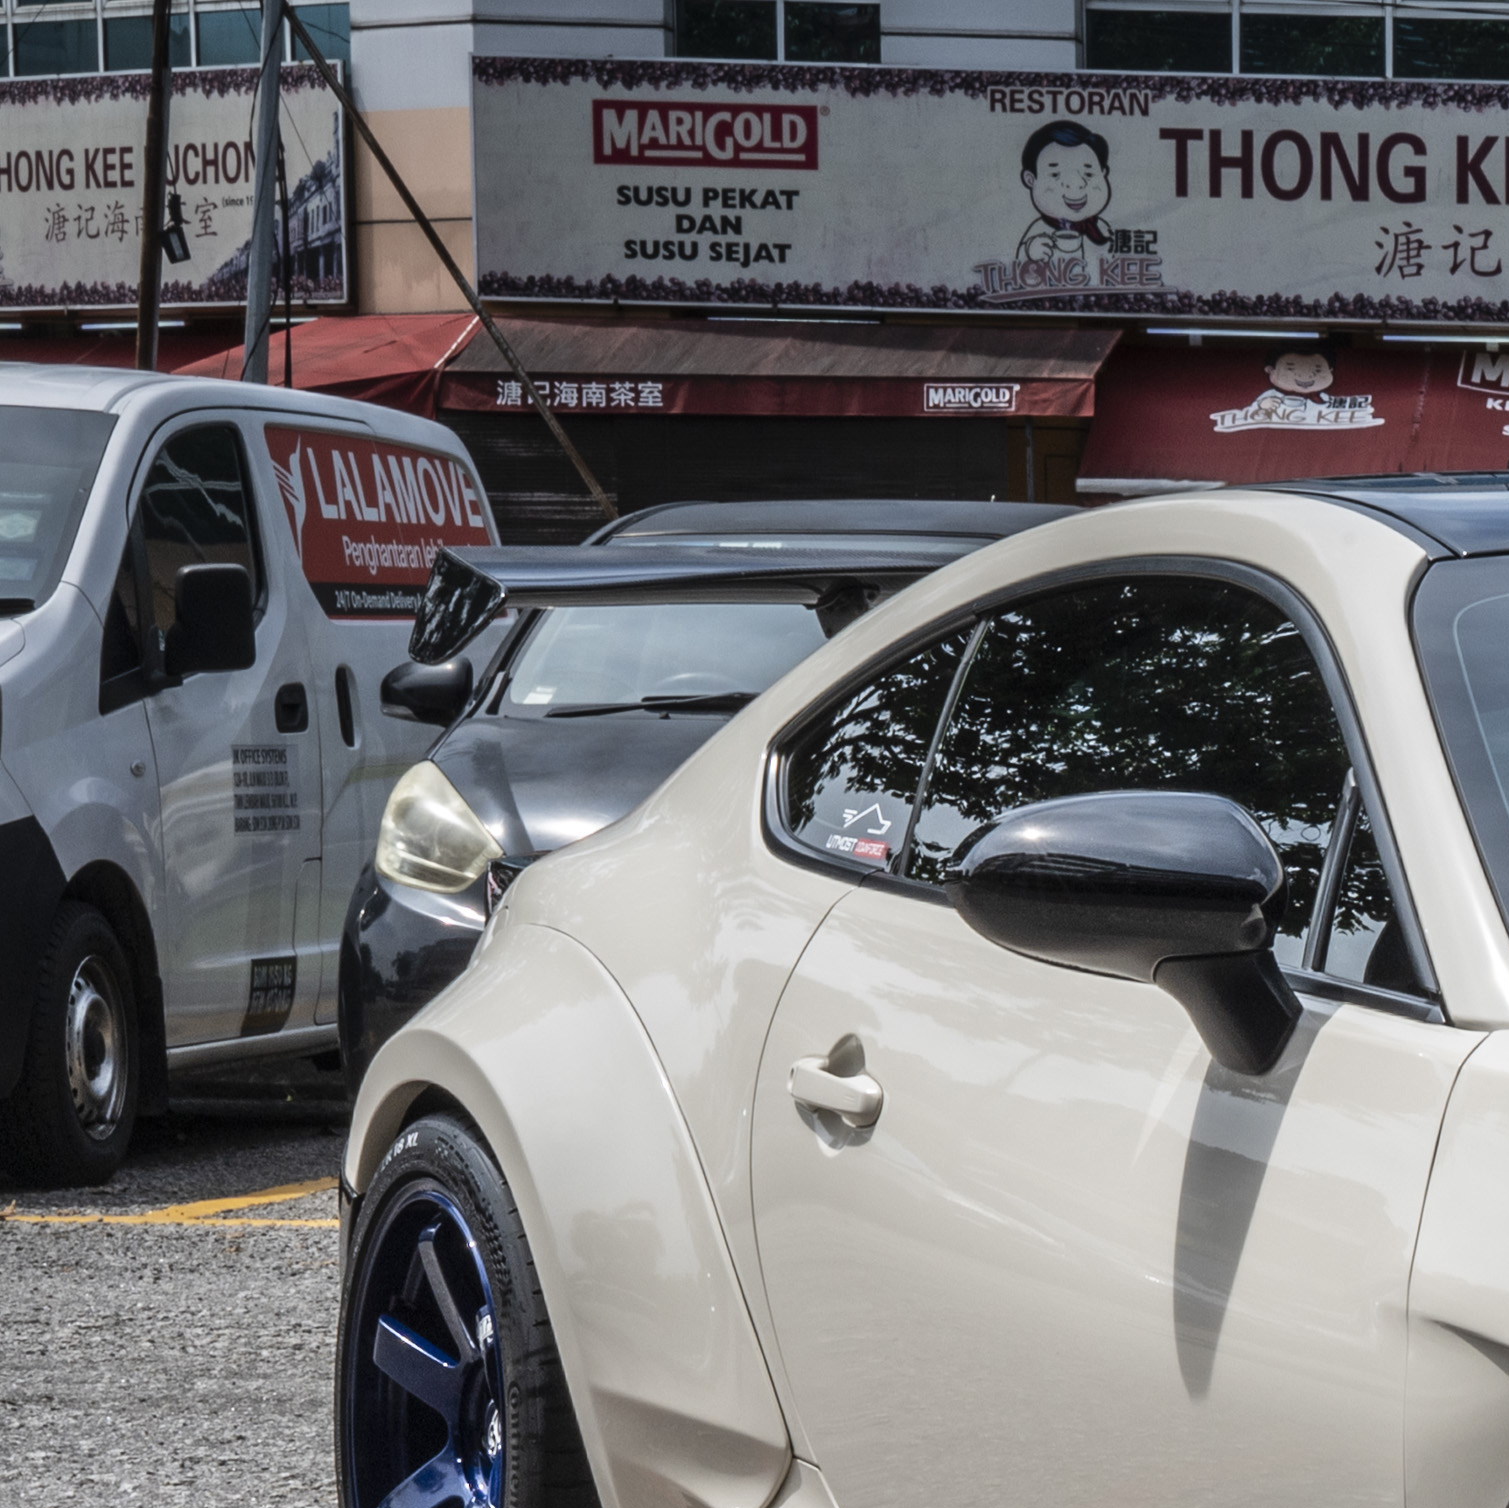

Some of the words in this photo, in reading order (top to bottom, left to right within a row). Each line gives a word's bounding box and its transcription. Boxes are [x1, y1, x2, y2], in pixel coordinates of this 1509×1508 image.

[989, 88, 1149, 117] RESTORAN
[602, 108, 807, 160] MARIGOLD
[0, 149, 75, 193] HONG
[84, 146, 135, 189] KEE
[1159, 128, 1427, 205] THONG
[616, 185, 692, 207] SUSU
[702, 187, 800, 210] PEKAT
[45, 197, 218, 242] 溏记海室
[675, 214, 742, 235] DAN
[624, 240, 699, 261] SUSU
[708, 242, 792, 268] SEJAT
[975, 256, 1090, 293] THONG
[1099, 256, 1162, 288] KEE
[928, 387, 1010, 408] MARIGOLD
[307, 447, 484, 528] LALAMOVE
[342, 535, 421, 576] Penghantaran
